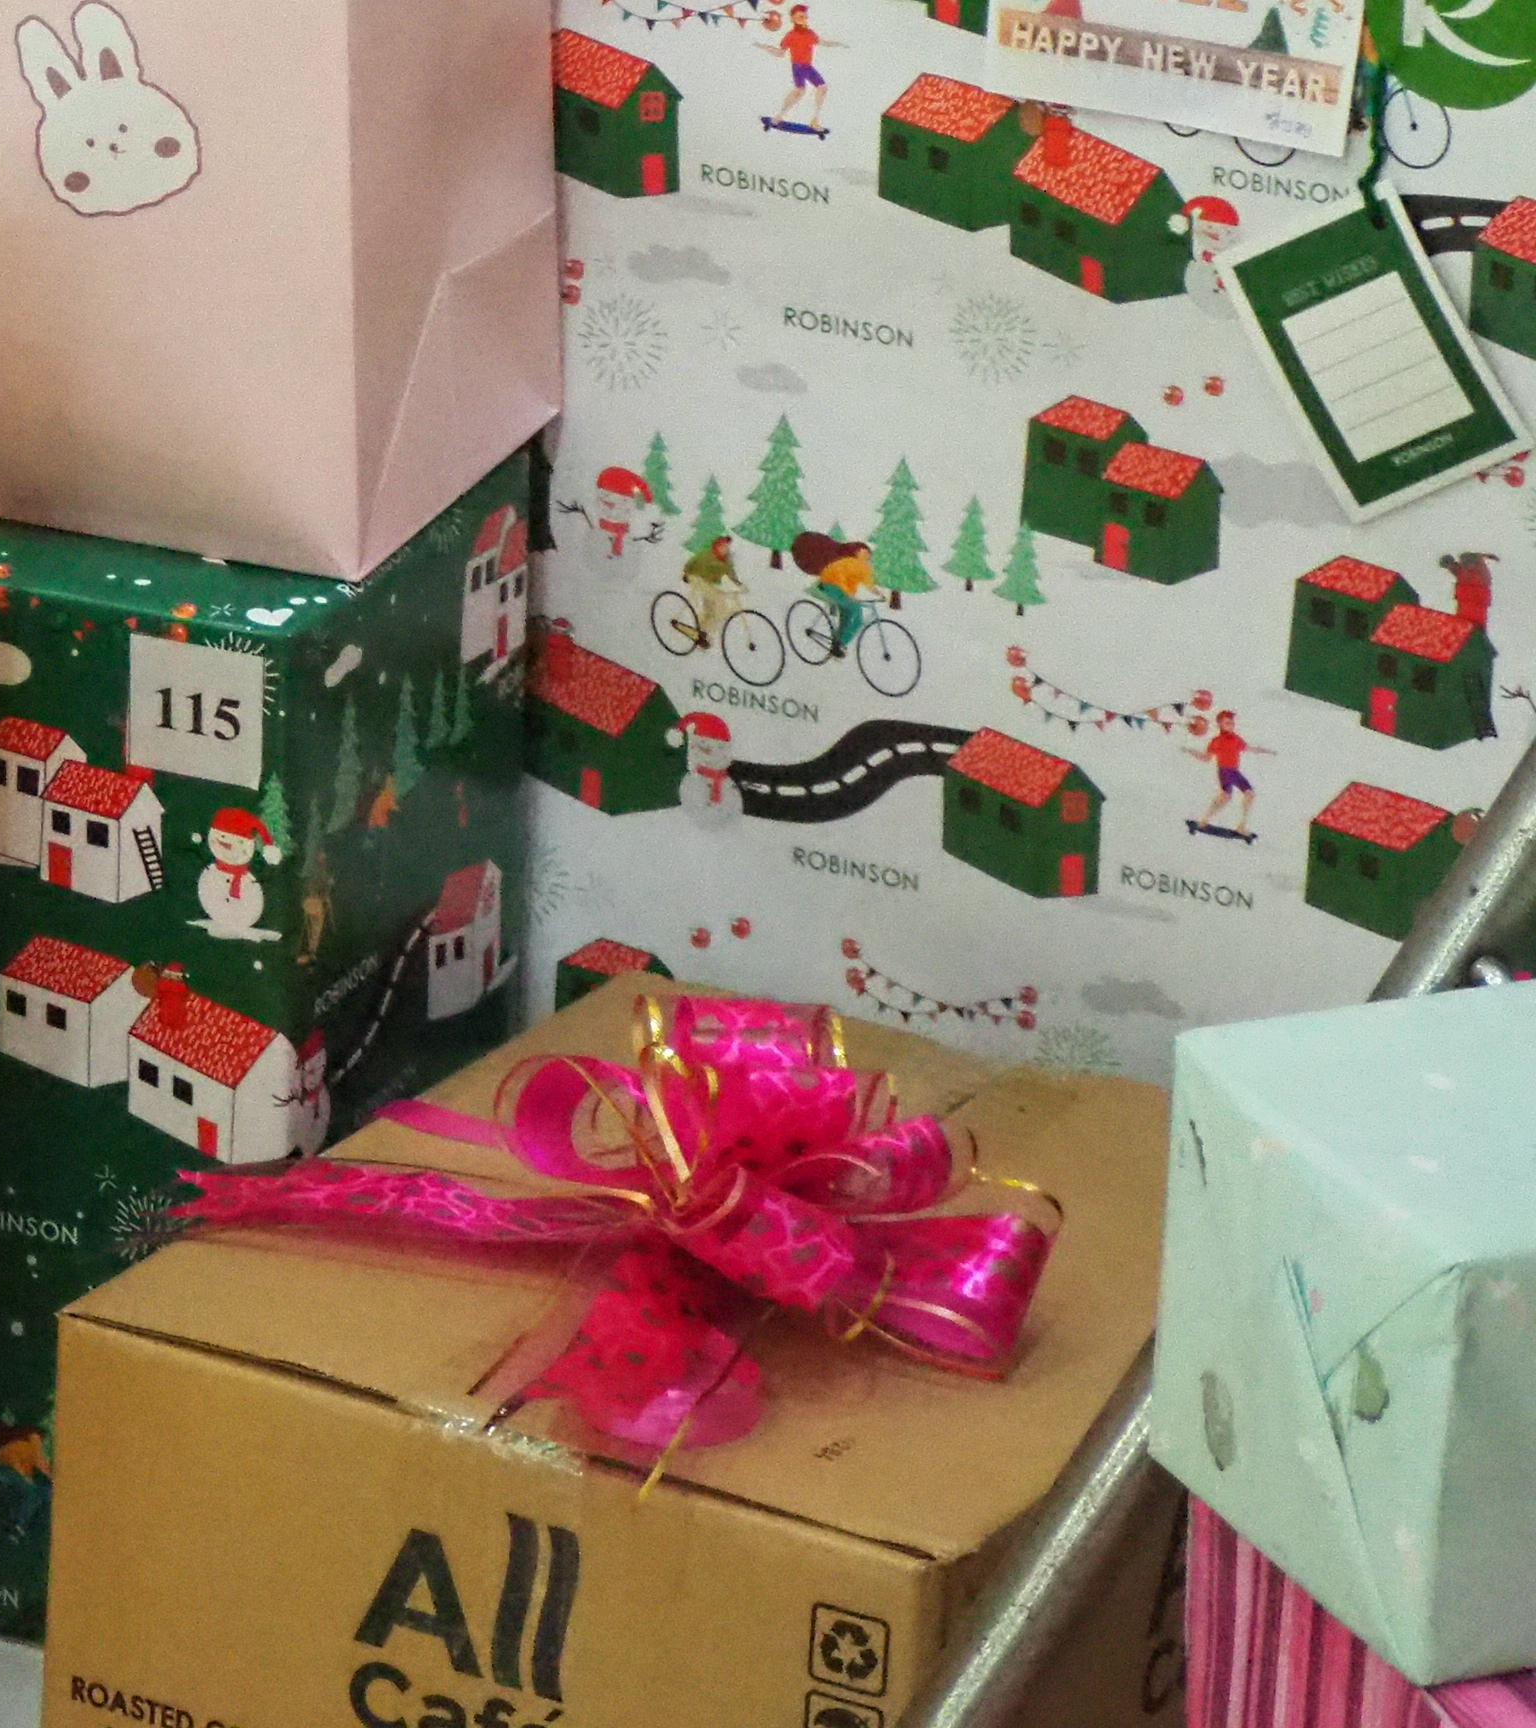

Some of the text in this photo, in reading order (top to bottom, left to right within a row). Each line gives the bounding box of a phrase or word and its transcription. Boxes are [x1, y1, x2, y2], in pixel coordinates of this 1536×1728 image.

[1011, 22, 1328, 103] HAPPY NEW YEAR
[700, 164, 832, 205] ROBINSON
[783, 306, 914, 349] ROBINSON
[155, 686, 242, 742] 115
[691, 678, 821, 723] ROBINSON
[792, 846, 920, 892] ROBINSON
[1119, 864, 1256, 912] ROBINSON
[353, 1512, 581, 1702] All
[70, 1675, 196, 1728] ROASTED
